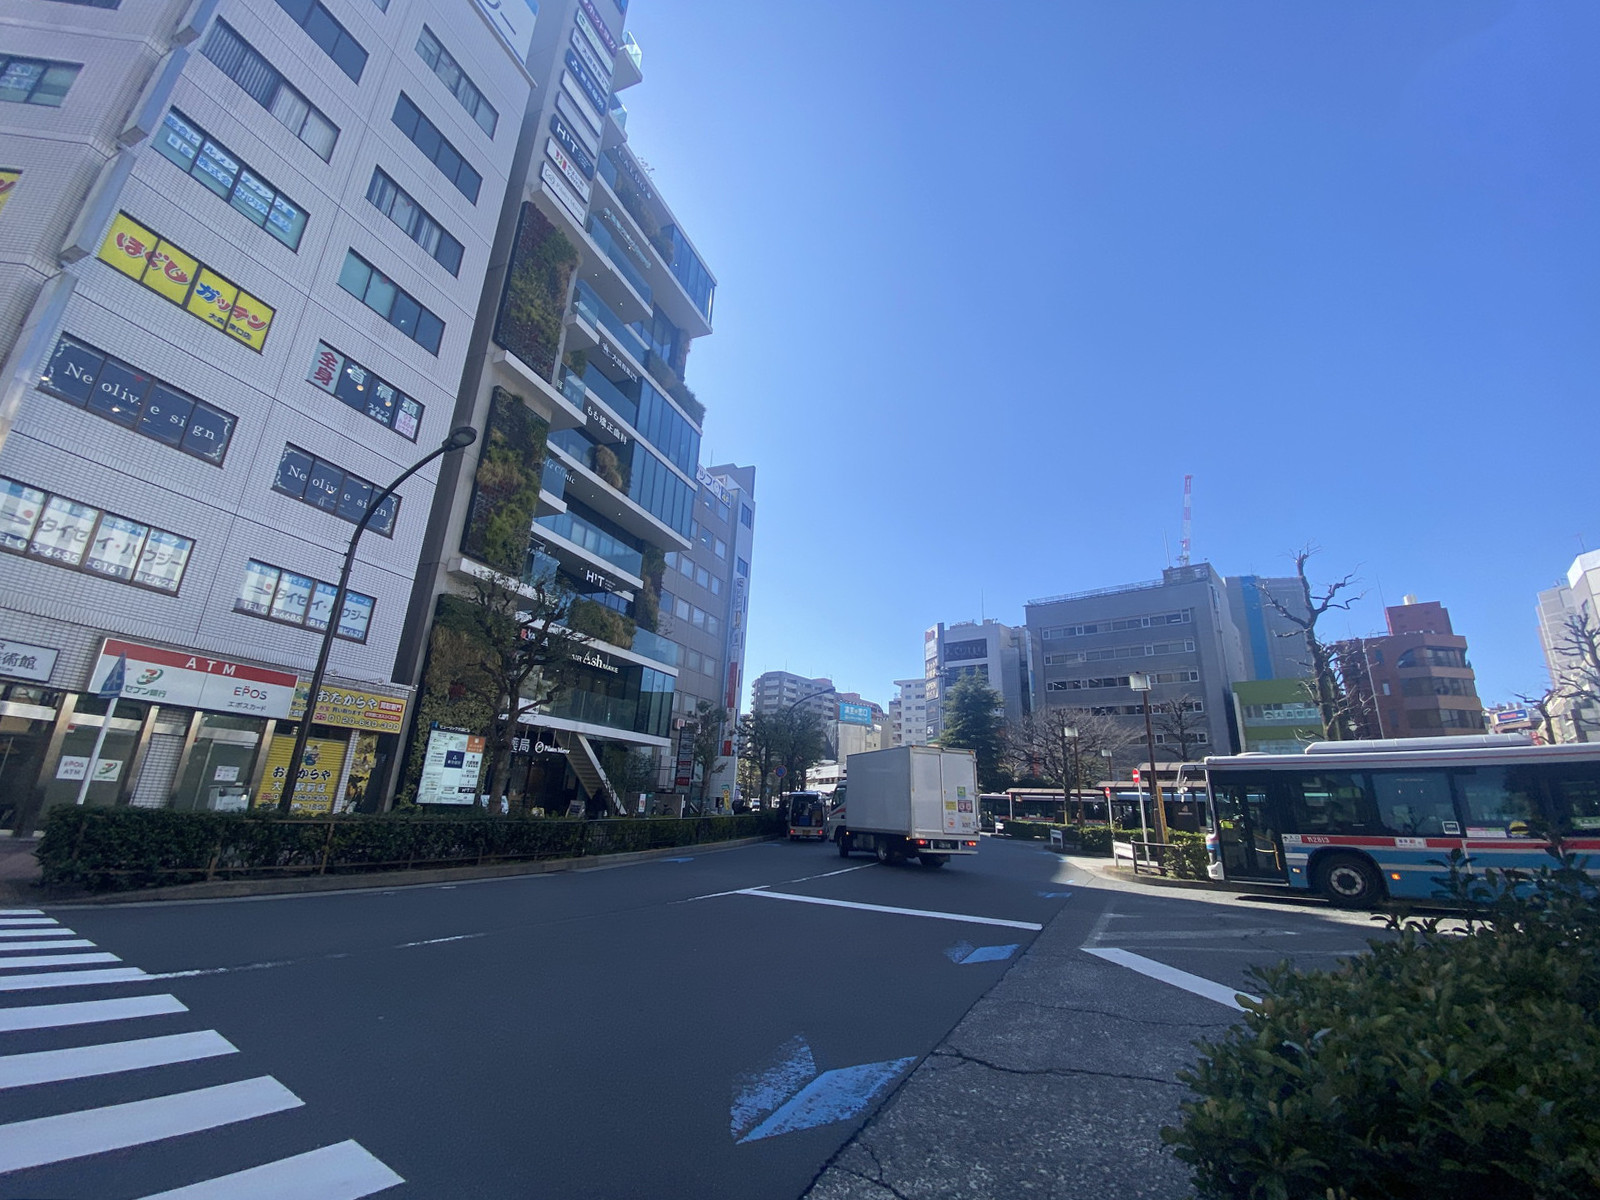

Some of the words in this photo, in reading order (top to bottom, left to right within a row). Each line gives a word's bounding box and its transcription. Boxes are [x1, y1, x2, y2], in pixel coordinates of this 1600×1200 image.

[196, 282, 268, 331] ガッテン
[169, 413, 216, 441] sign
[276, 588, 368, 621] タイセイ・ウジー
[261, 602, 329, 630] 03-6685-816
[0, 652, 38, 671] 術館
[185, 657, 236, 676] ATM
[125, 685, 168, 698] セブン銀行
[317, 689, 378, 710] おたからや
[273, 766, 331, 781] おからや
[271, 781, 326, 793] 大駅前店
